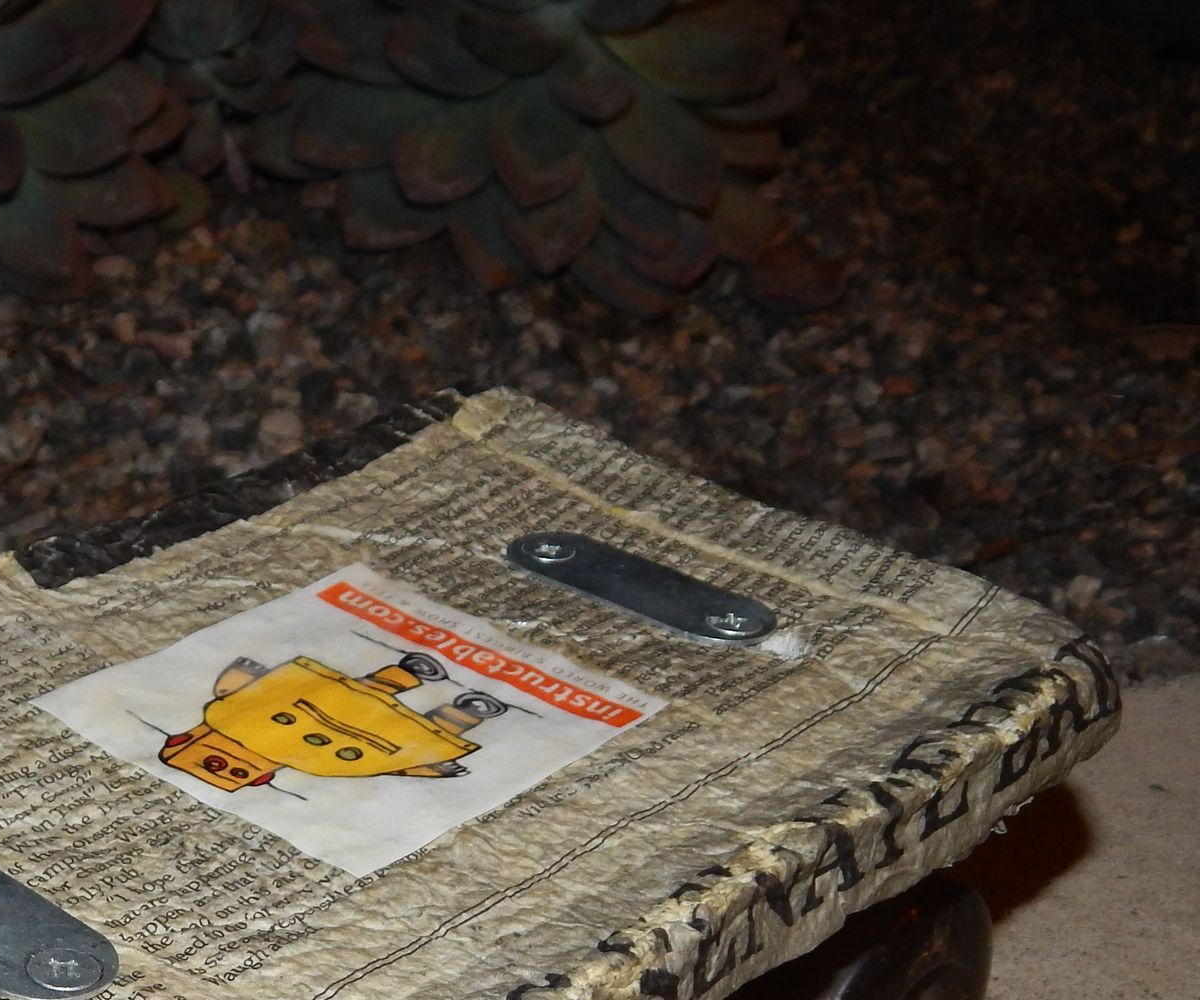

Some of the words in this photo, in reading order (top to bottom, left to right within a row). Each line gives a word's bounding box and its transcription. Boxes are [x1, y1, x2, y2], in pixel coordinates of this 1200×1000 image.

[338, 590, 623, 721] instructables.com
[34, 759, 47, 769] a
[31, 819, 56, 833] on
[62, 814, 93, 835] the
[116, 808, 176, 845] Waugh
[7, 861, 26, 876] of
[100, 868, 144, 889] Pub.
[354, 875, 374, 889] as
[119, 907, 193, 943] happen,
[223, 871, 257, 892] that
[141, 934, 174, 954] the
[215, 905, 240, 920] on
[238, 886, 271, 906] this
[164, 935, 209, 965] need
[113, 968, 146, 988] the
[201, 950, 270, 986] Waugh
